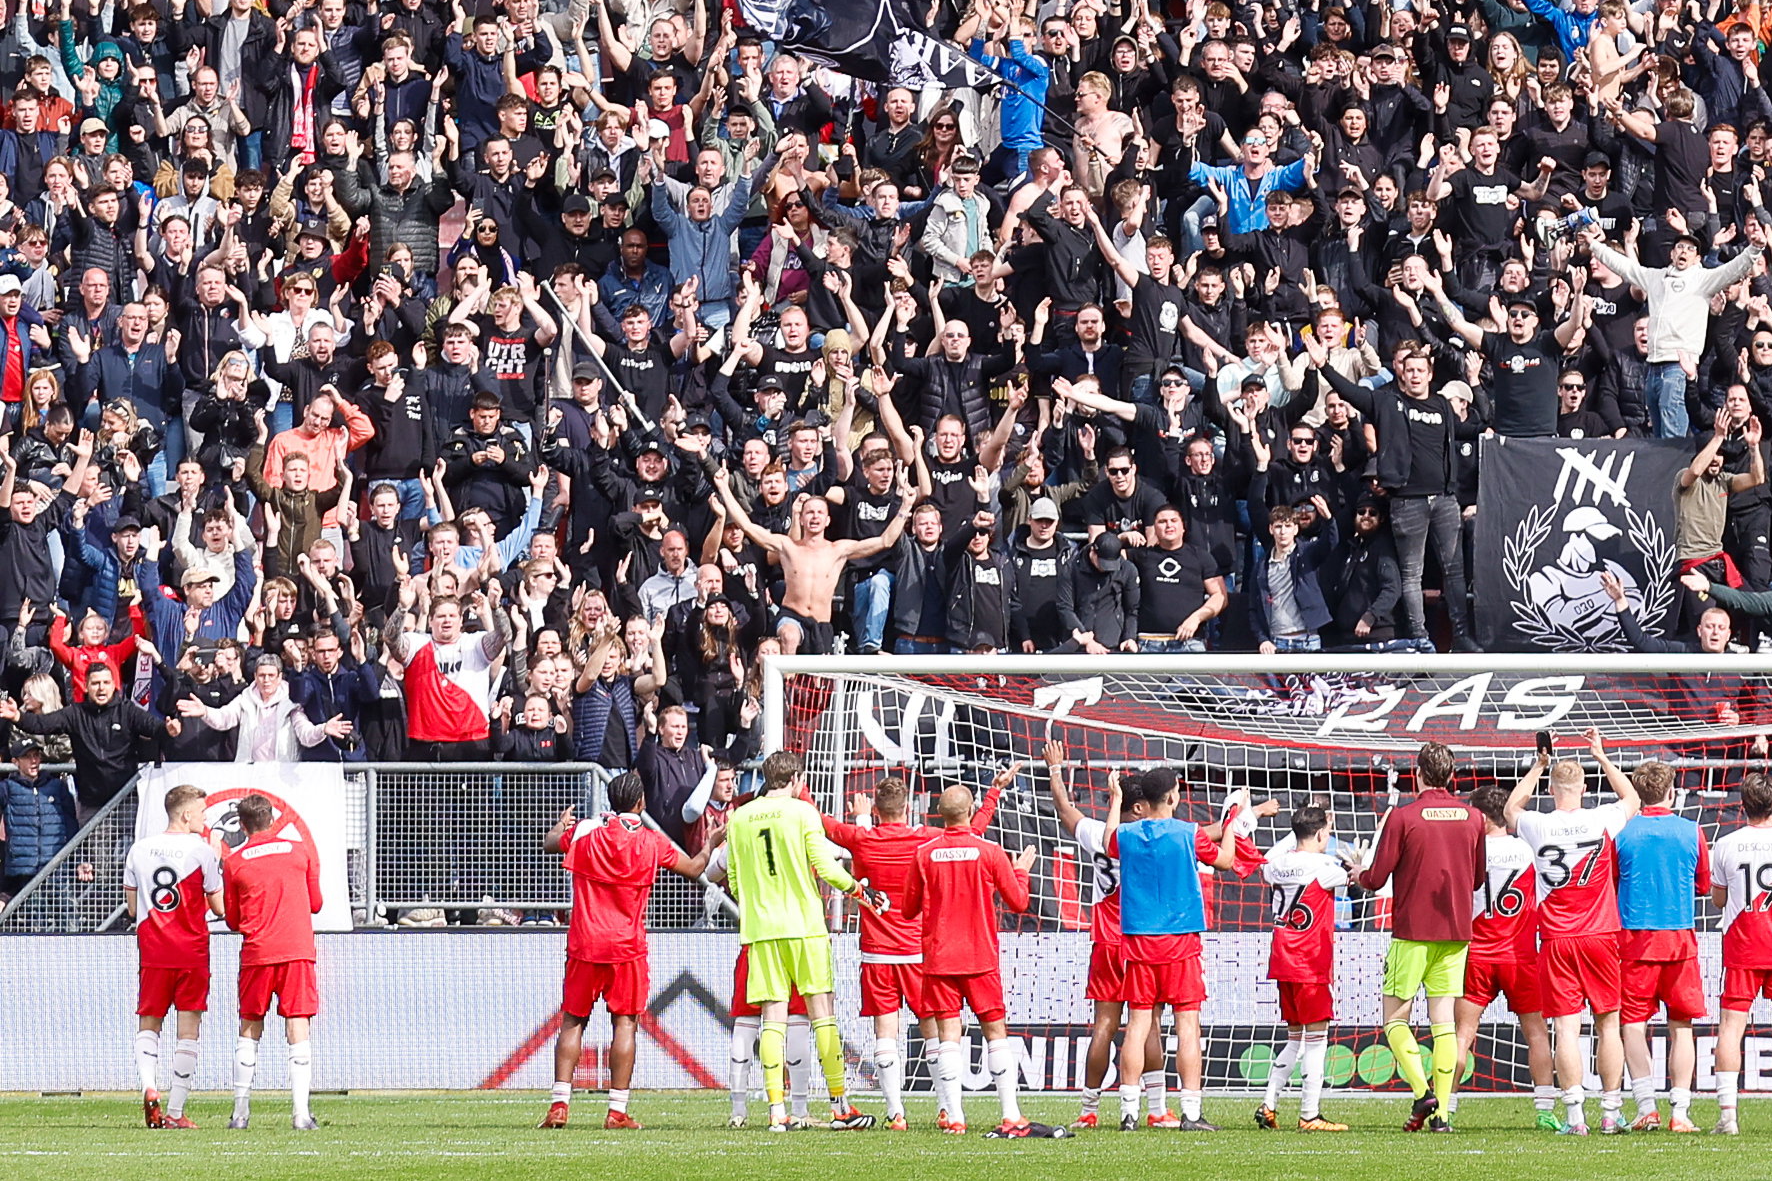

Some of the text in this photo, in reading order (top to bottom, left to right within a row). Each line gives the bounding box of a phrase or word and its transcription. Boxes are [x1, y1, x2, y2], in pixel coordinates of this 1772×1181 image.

[485, 358, 527, 374] CHT
[488, 343, 526, 360] UTR
[1573, 598, 1595, 616] 030
[748, 810, 782, 823] BARKAS
[150, 847, 184, 861] FRAULO
[757, 826, 778, 877] 1
[935, 849, 969, 861] DASSY
[1536, 835, 1607, 889] 37
[150, 865, 181, 913] 8
[1484, 868, 1525, 920] 16
[1272, 882, 1314, 931] 26
[961, 1035, 1207, 1091] UNIBT
